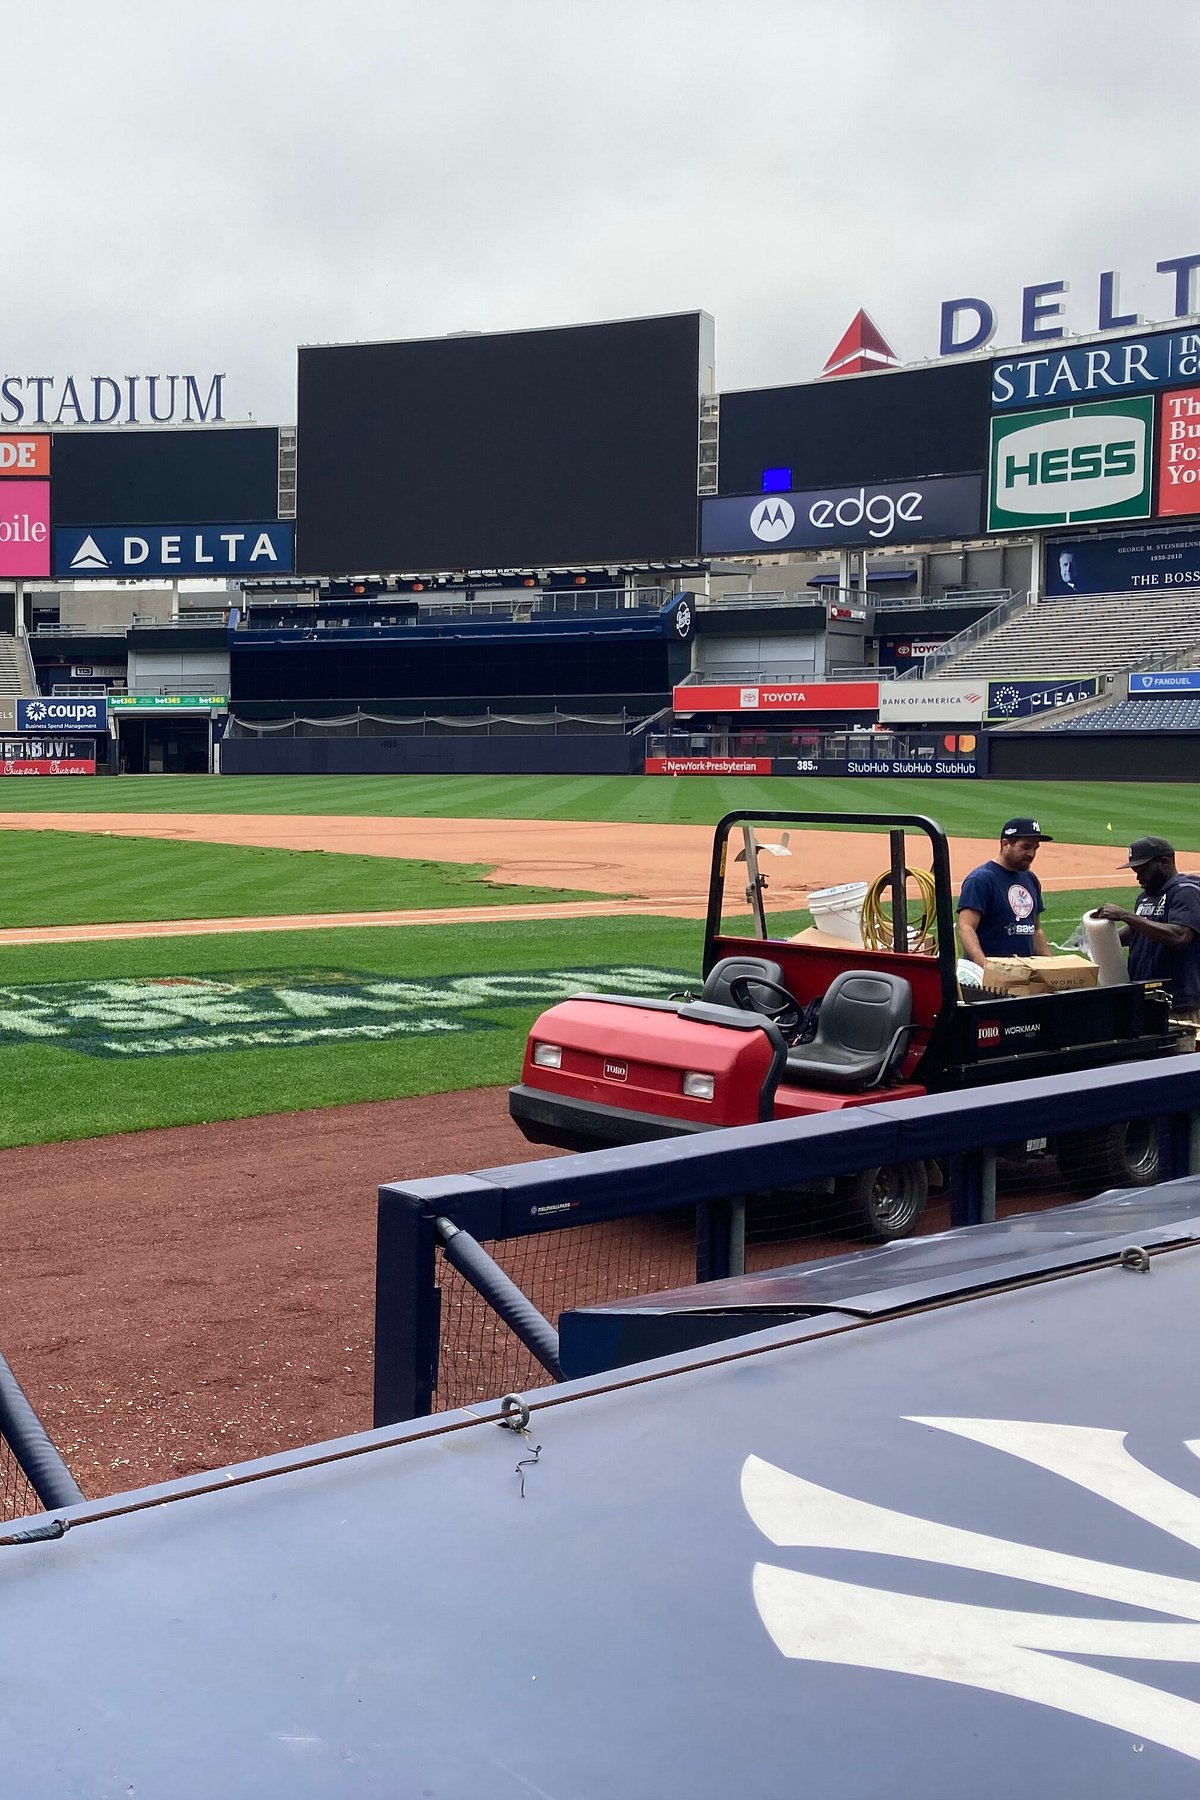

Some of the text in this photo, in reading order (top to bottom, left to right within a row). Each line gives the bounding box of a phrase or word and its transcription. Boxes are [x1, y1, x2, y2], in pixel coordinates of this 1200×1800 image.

[991, 343, 1160, 404] STARR
[0, 372, 227, 425] STADIUM
[1005, 440, 1136, 488] HESS
[808, 487, 923, 538] edge
[123, 533, 278, 565] DELTA
[1131, 570, 1200, 586] THE BOSS
[1154, 677, 1191, 686] FANDUEL
[762, 692, 806, 703] TOYOTA
[920, 697, 962, 705] AMERICA
[47, 704, 97, 721] coupa
[47, 723, 64, 731] Spend
[64, 723, 97, 731] Management
[796, 760, 812, 771] 385
[847, 762, 889, 774] StubHub
[892, 762, 932, 774] StubHub
[935, 762, 976, 774] StubHub
[978, 1023, 1041, 1040] TORO WORKMAN
[605, 1064, 626, 1076] TORO
